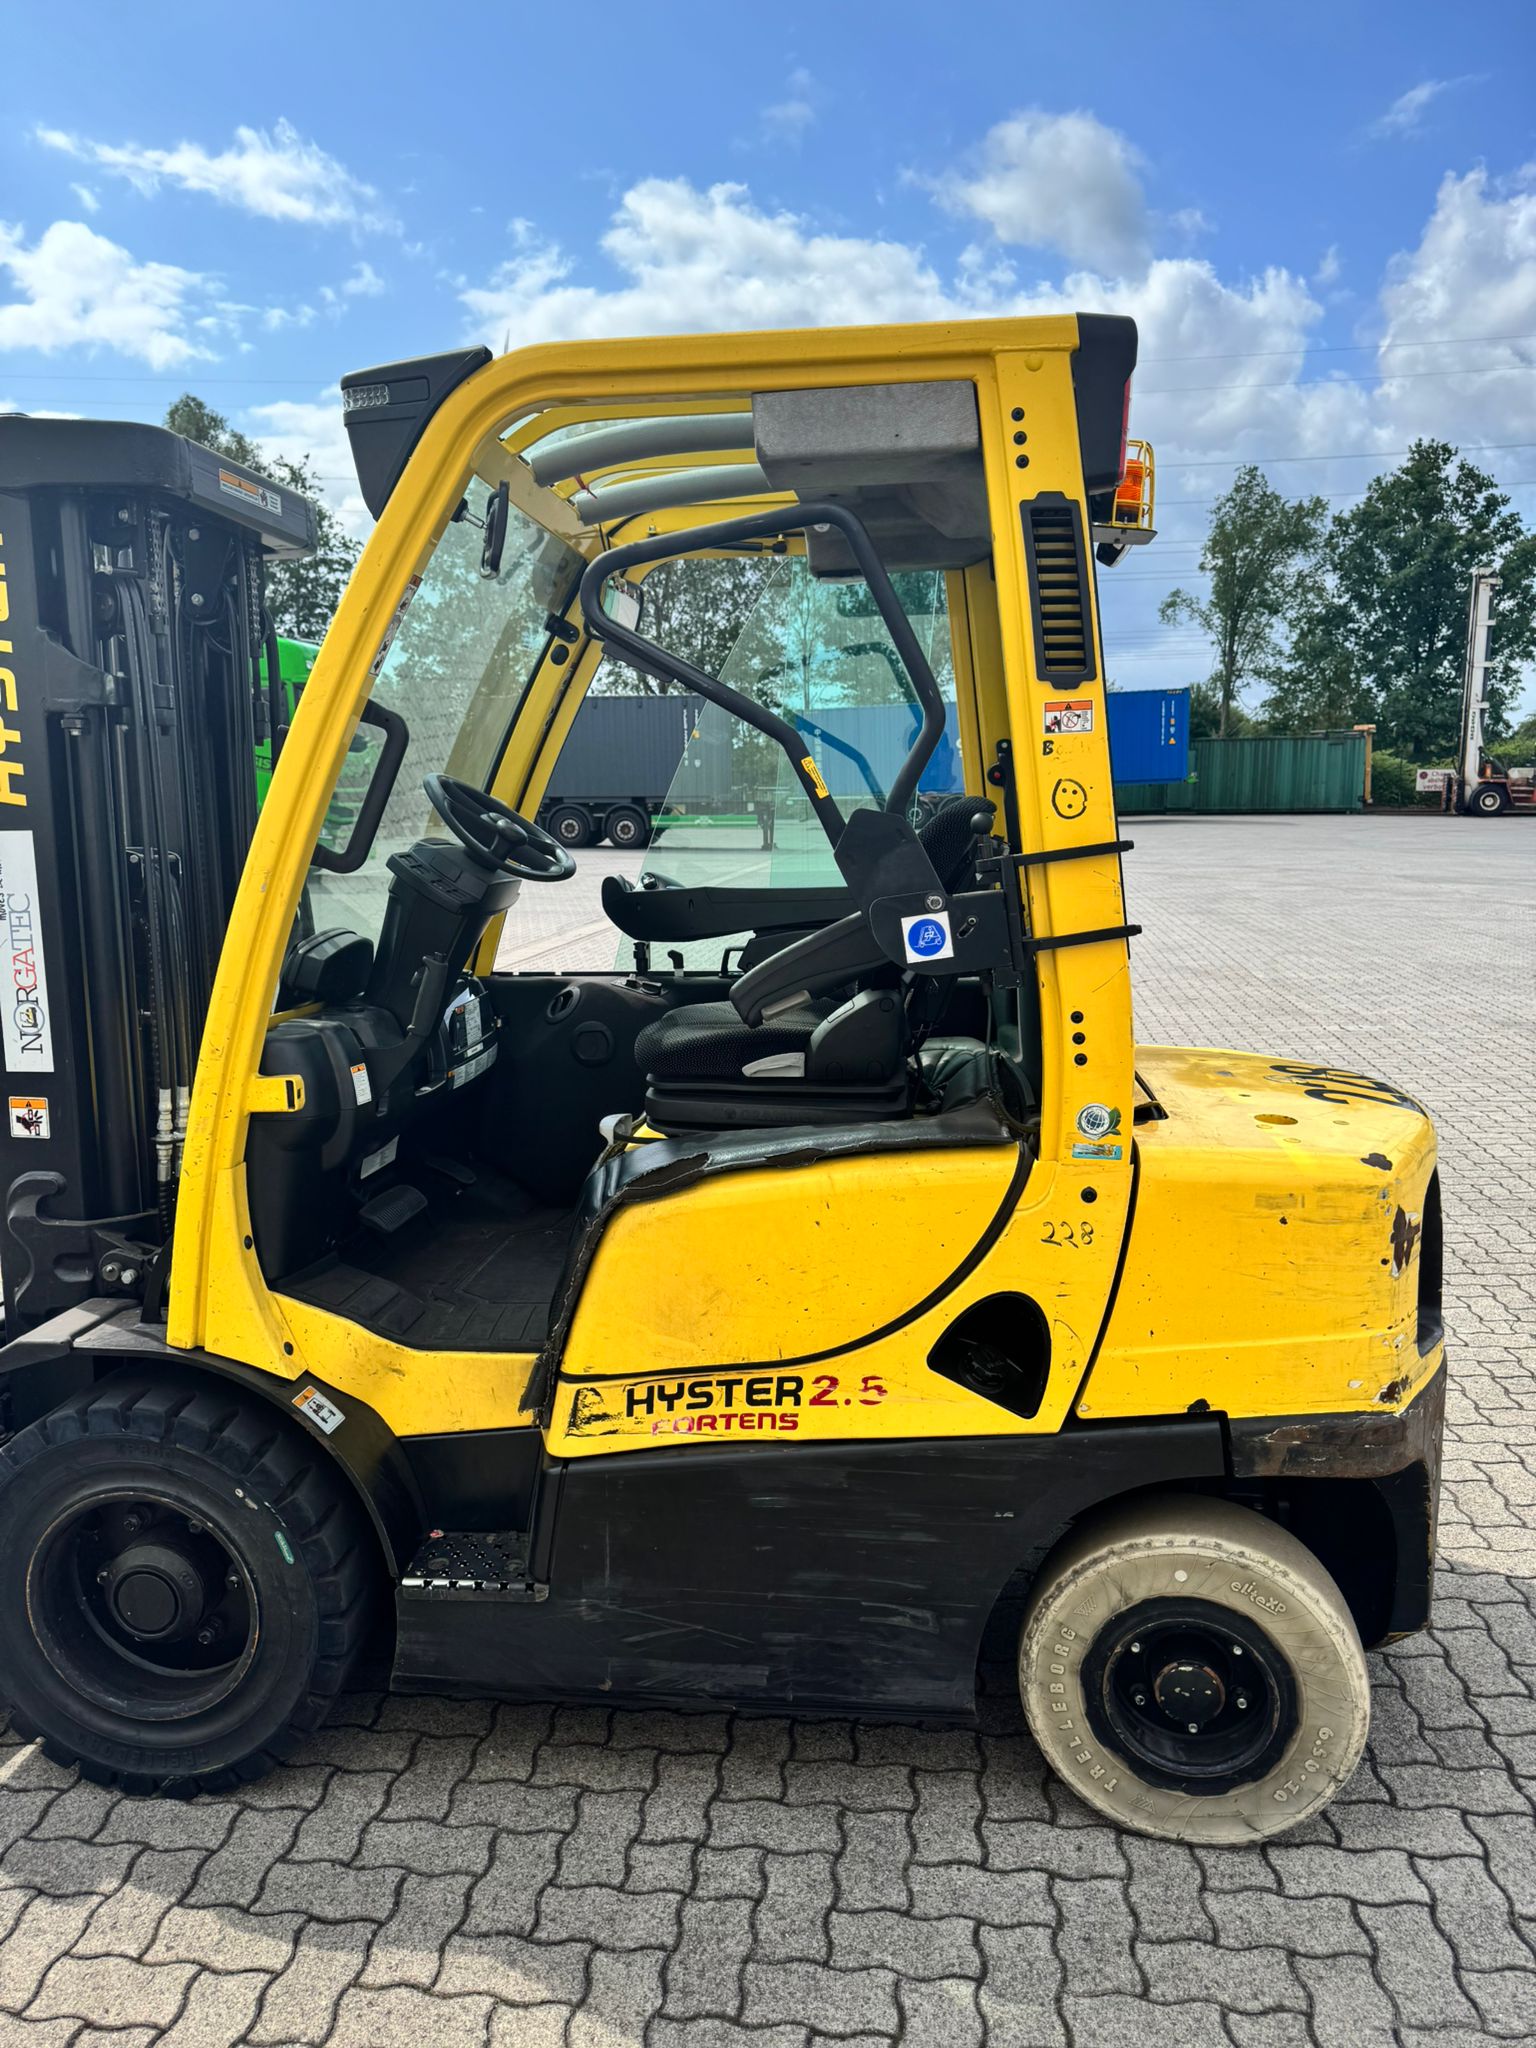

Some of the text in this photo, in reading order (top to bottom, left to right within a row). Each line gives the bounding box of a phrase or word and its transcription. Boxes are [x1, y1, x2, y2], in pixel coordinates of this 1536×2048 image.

[7, 893, 45, 1055] NORGATEC
[1040, 1221, 1094, 1248] 228
[626, 1374, 888, 1417] HYSTER 2.5
[652, 1413, 799, 1435] FORTENS
[1050, 1627, 1118, 1793] TRELLEBORG
